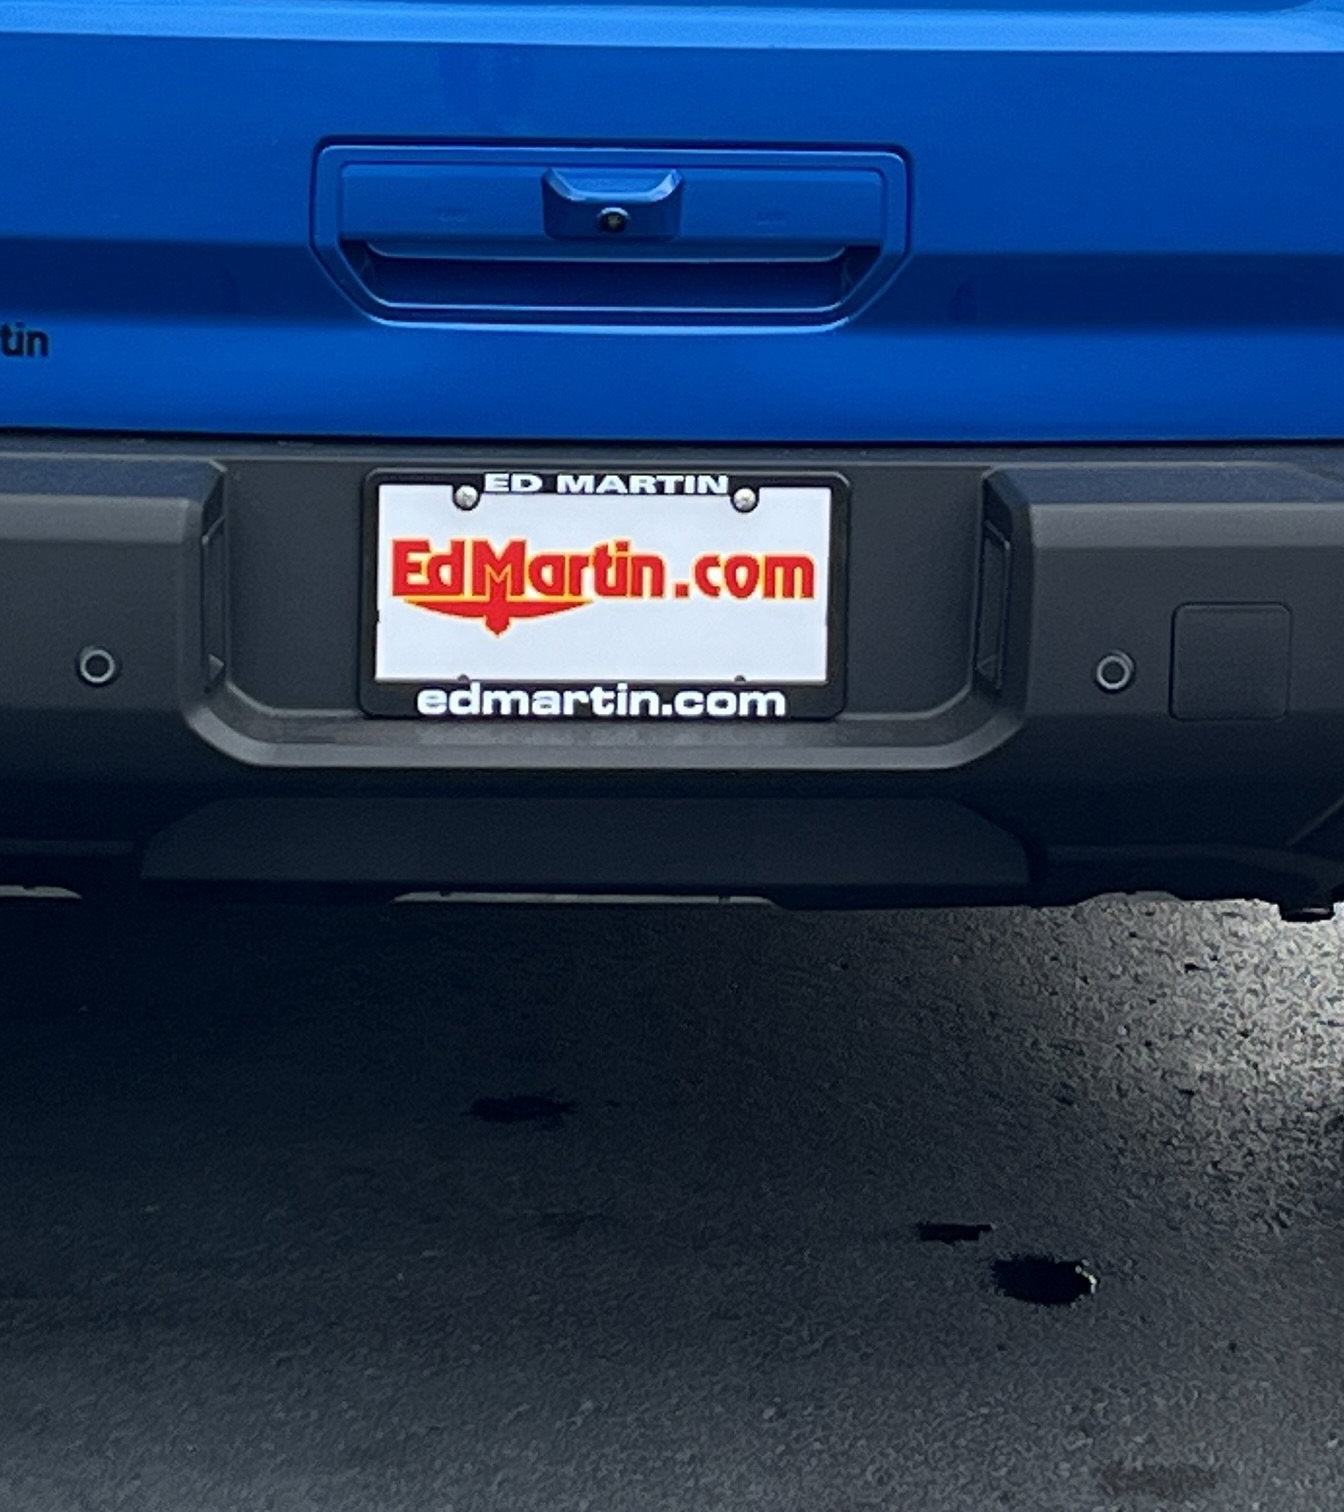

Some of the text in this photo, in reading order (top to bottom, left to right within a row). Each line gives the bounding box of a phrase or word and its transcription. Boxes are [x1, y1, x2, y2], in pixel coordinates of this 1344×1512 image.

[483, 472, 729, 495] ED MARTIN
[416, 683, 787, 718] edmartin.com
